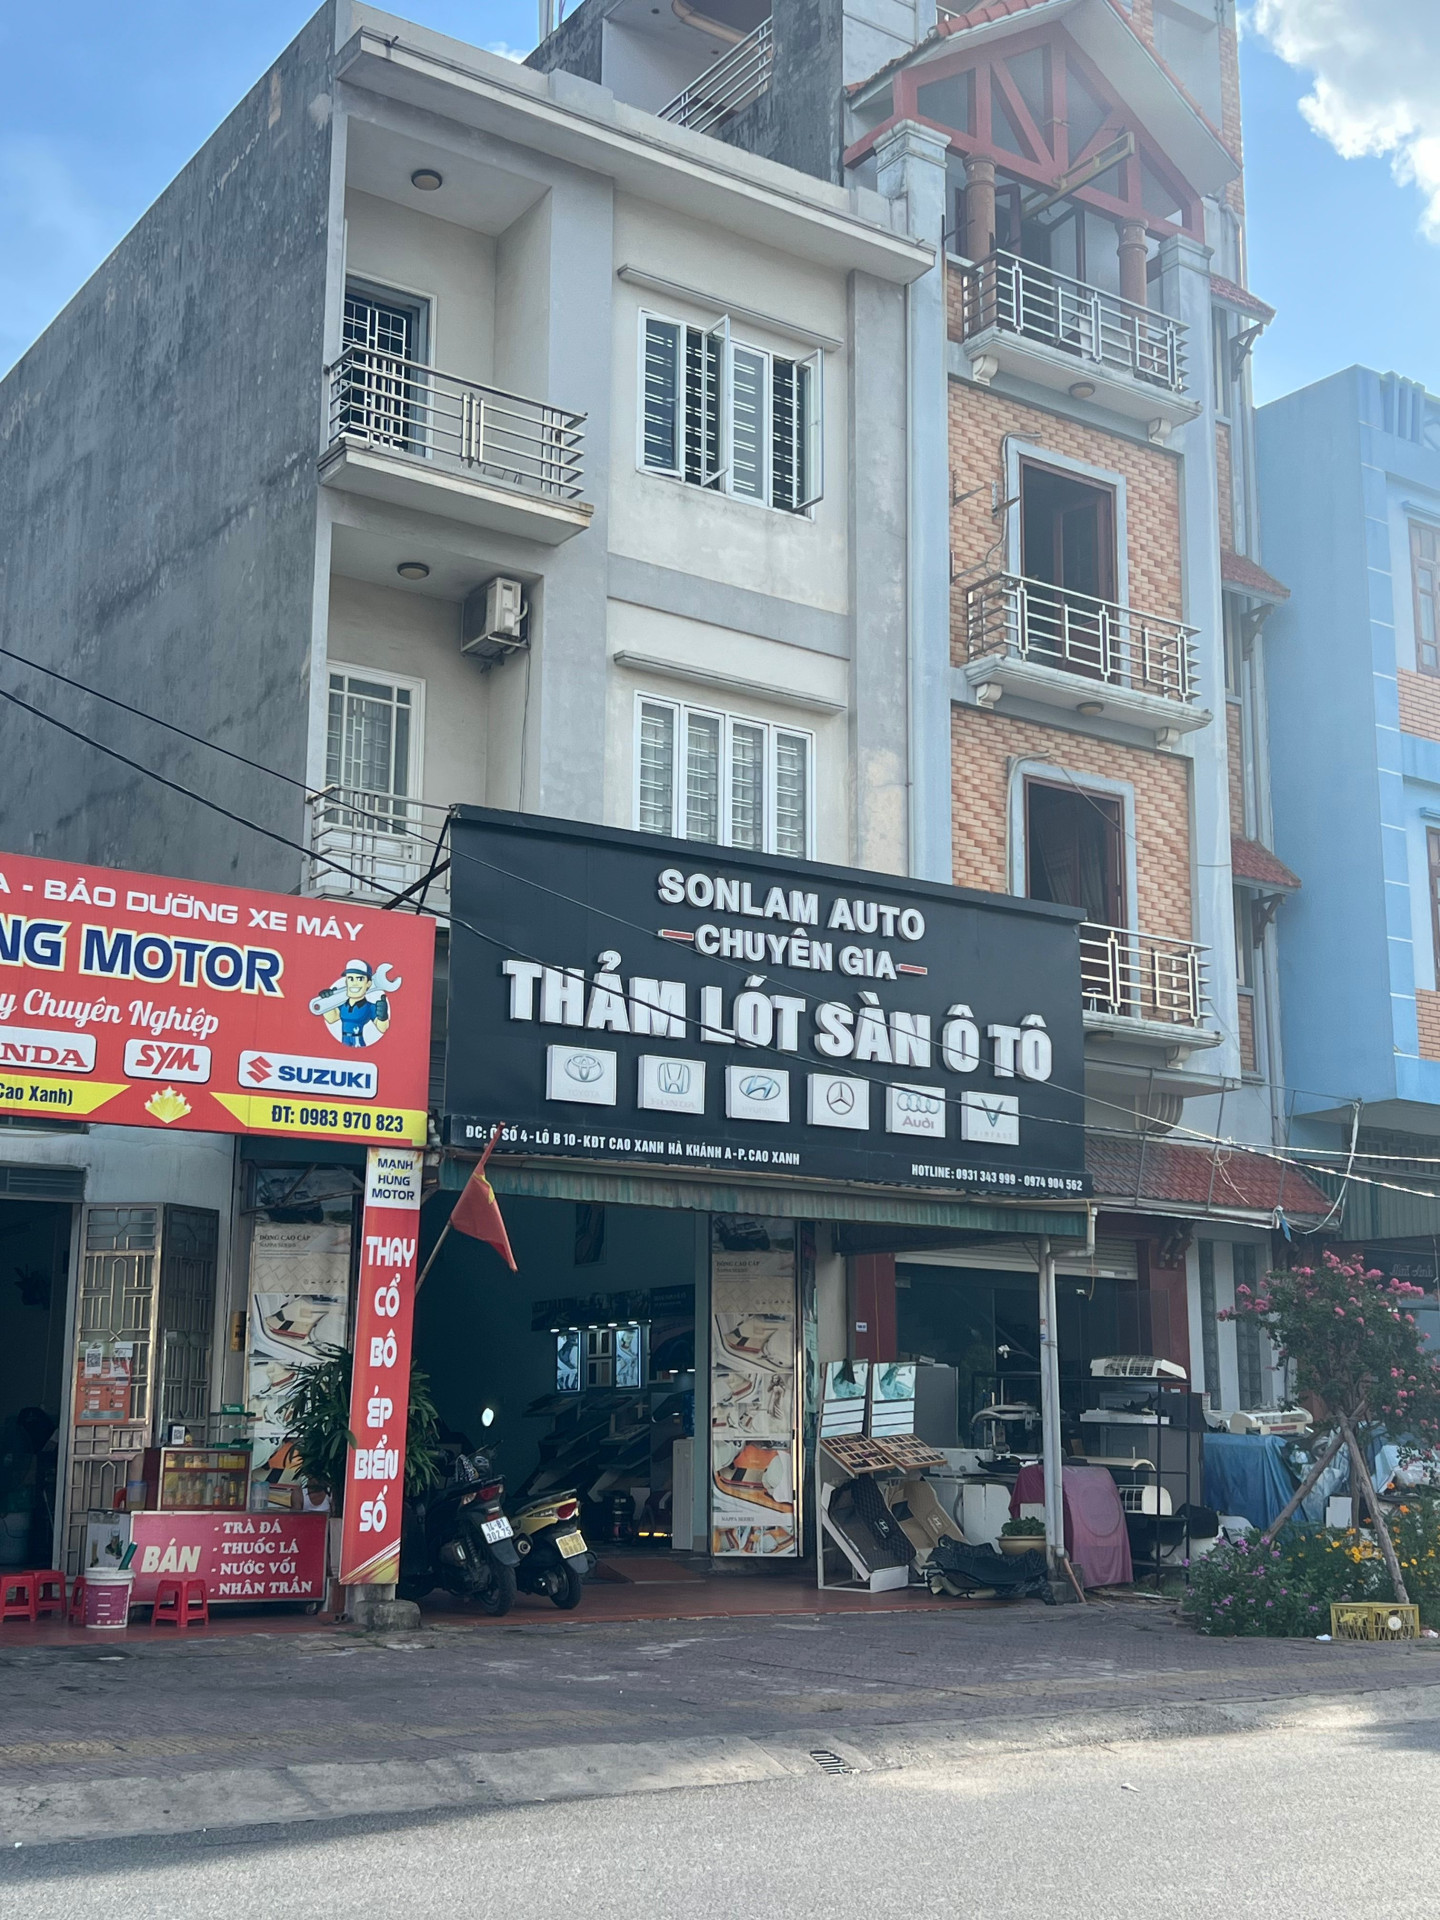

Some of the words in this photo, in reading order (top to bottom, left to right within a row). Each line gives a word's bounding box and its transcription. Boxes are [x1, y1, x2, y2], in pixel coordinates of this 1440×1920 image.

[44, 877, 117, 908] BẢO
[126, 891, 239, 926] DƯỠNG
[248, 907, 288, 932] XE
[296, 915, 364, 942] MÁY
[657, 868, 819, 926] SONLAM
[827, 897, 926, 942] AUTO
[81, 924, 285, 998] MOTOR
[695, 924, 833, 973] CHUYÊN
[839, 945, 898, 980] GIA
[24, 988, 122, 1028] Chuyên
[129, 1000, 219, 1041] Nghiệp
[502, 950, 687, 1039] THẢM
[701, 975, 807, 1053] LÓT
[814, 990, 931, 1068] SÀN
[942, 1004, 980, 1073] Ô
[987, 1014, 1052, 1082] TÔ
[135, 1044, 200, 1075] SYM
[278, 1065, 371, 1089] SUZUKI
[29, 1085, 73, 1106] Xanh)
[650, 1098, 696, 1110] HONDA
[272, 1105, 295, 1124] ĐT:
[300, 1107, 338, 1128] 0983
[343, 1111, 371, 1130] 970
[376, 1114, 404, 1133] 823
[902, 1115, 934, 1129] Audi
[466, 1125, 487, 1139] ĐC:
[501, 1124, 519, 1142] SỐ
[553, 1132, 561, 1145] B
[609, 1136, 631, 1151] CAO
[634, 1139, 664, 1154] XANH
[668, 1140, 683, 1155] HÀ
[686, 1142, 722, 1159] KHÁNH
[772, 1151, 800, 1166] XANH
[377, 1158, 413, 1171] MẠNH
[378, 1173, 410, 1187] HÙNG
[956, 1168, 978, 1181] 0931
[980, 1170, 997, 1183] 343
[999, 1173, 1016, 1185] 999
[1024, 1174, 1045, 1188] 0974
[1047, 1177, 1064, 1190] 904
[1065, 1179, 1083, 1191] 562
[372, 1188, 415, 1201] MOTOR
[366, 1236, 416, 1267] THAY
[374, 1273, 400, 1318] CỔ
[369, 1328, 398, 1368] BÔ
[366, 1385, 393, 1428] ÉP
[354, 1434, 399, 1480] BIỂN
[359, 1485, 388, 1532] SỐ
[223, 1519, 255, 1534] TRÀ
[259, 1519, 282, 1534] ĐÁ
[141, 1538, 201, 1573] BÁN
[221, 1537, 275, 1555] THUỐC
[279, 1539, 299, 1554] LÁ
[220, 1559, 267, 1575] NƯỚC
[270, 1557, 296, 1574] VỐI
[219, 1579, 265, 1596] NHÂN
[269, 1576, 312, 1593] TRẦN
